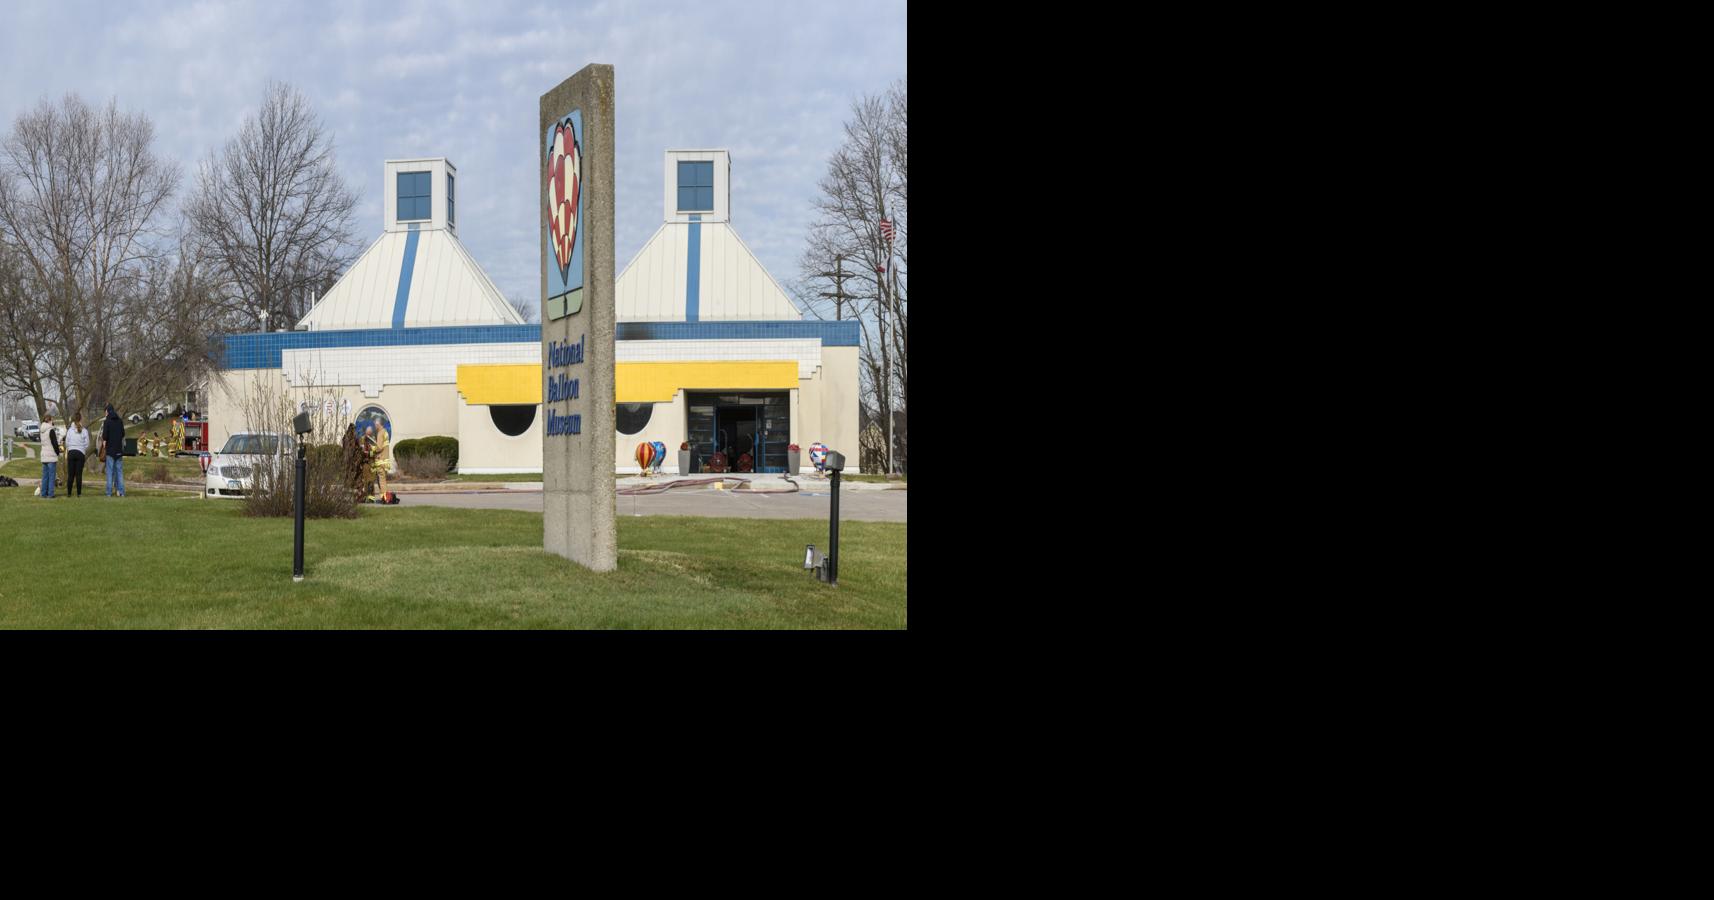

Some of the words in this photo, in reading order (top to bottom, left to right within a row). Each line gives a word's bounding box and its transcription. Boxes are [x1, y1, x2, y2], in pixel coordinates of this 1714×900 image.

[548, 334, 584, 370] National
[548, 373, 579, 404] Balloon
[547, 408, 581, 437] Museum
